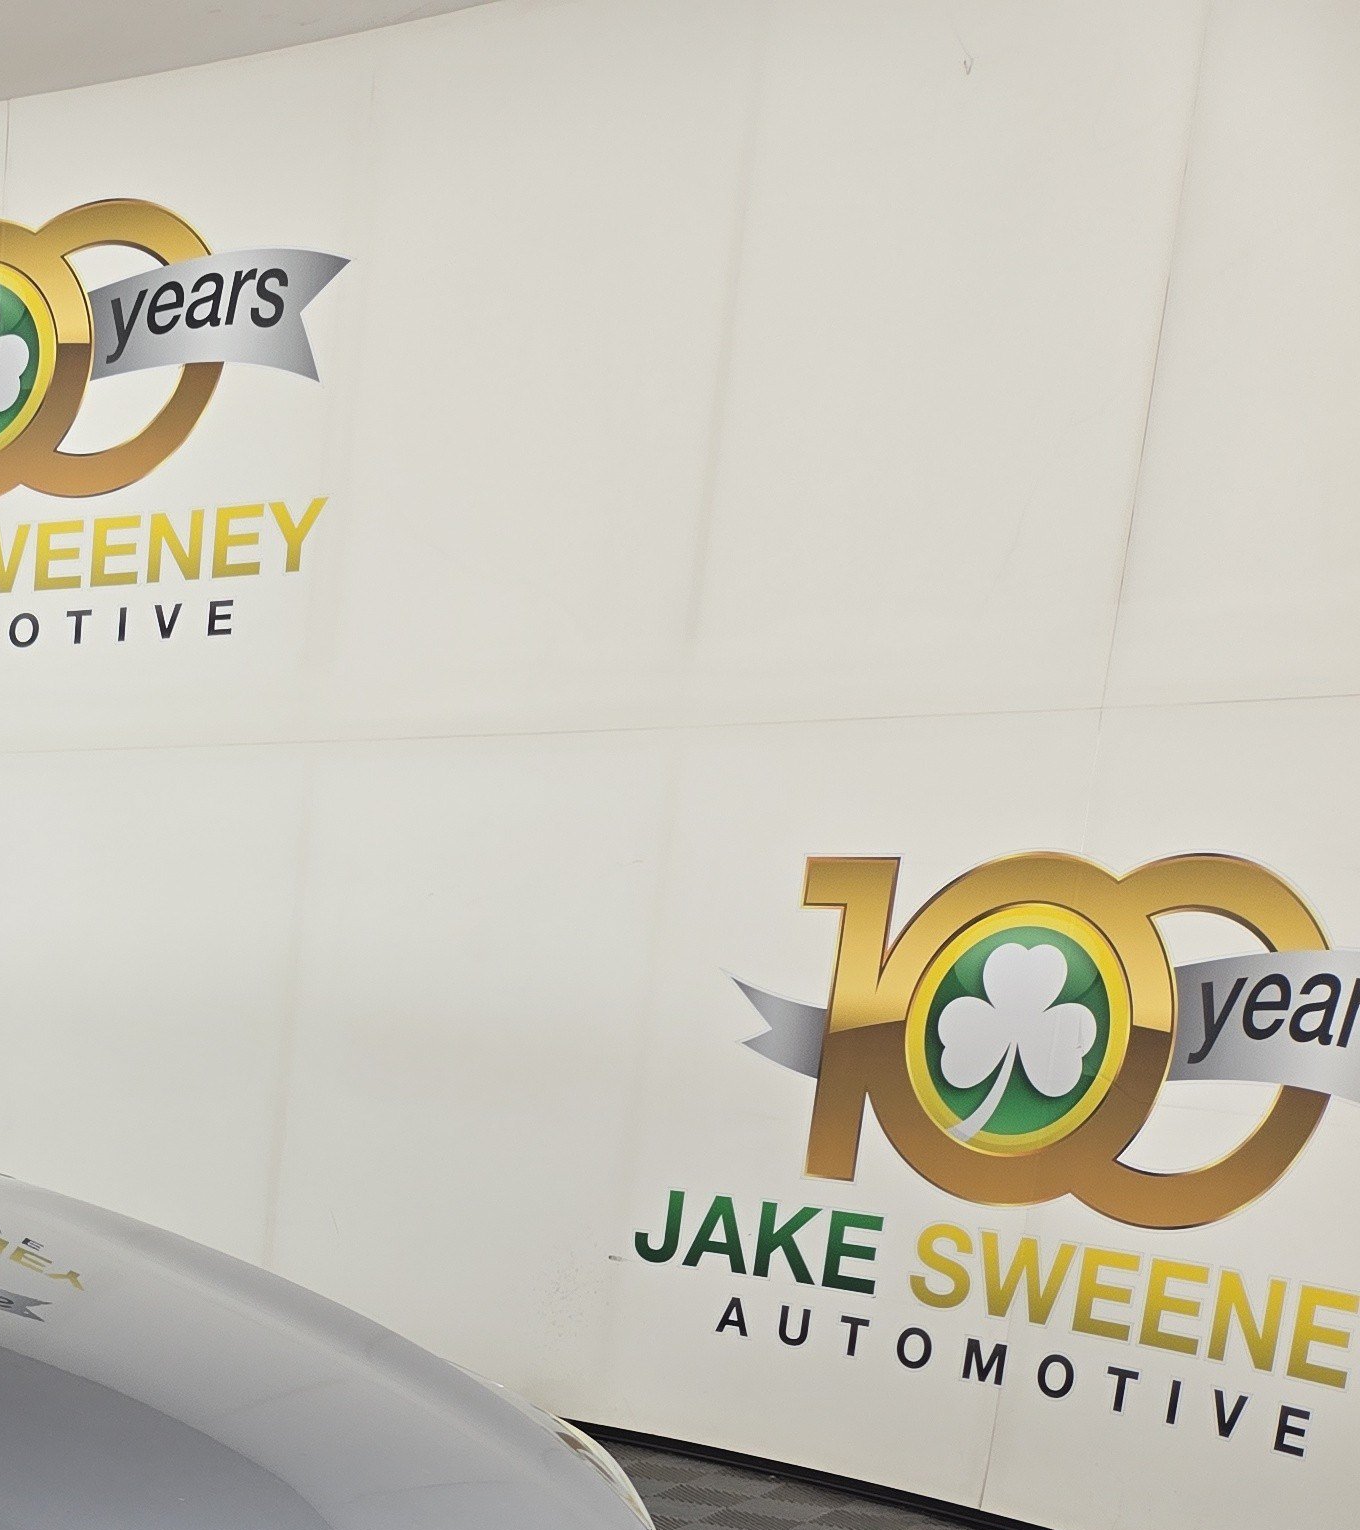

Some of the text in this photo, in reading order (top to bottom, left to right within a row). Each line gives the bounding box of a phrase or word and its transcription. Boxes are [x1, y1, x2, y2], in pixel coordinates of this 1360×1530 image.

[106, 267, 289, 364] years
[635, 1190, 1360, 1388] JAKE SWEENE
[715, 1296, 1311, 1457] AUTOMOTIVE
